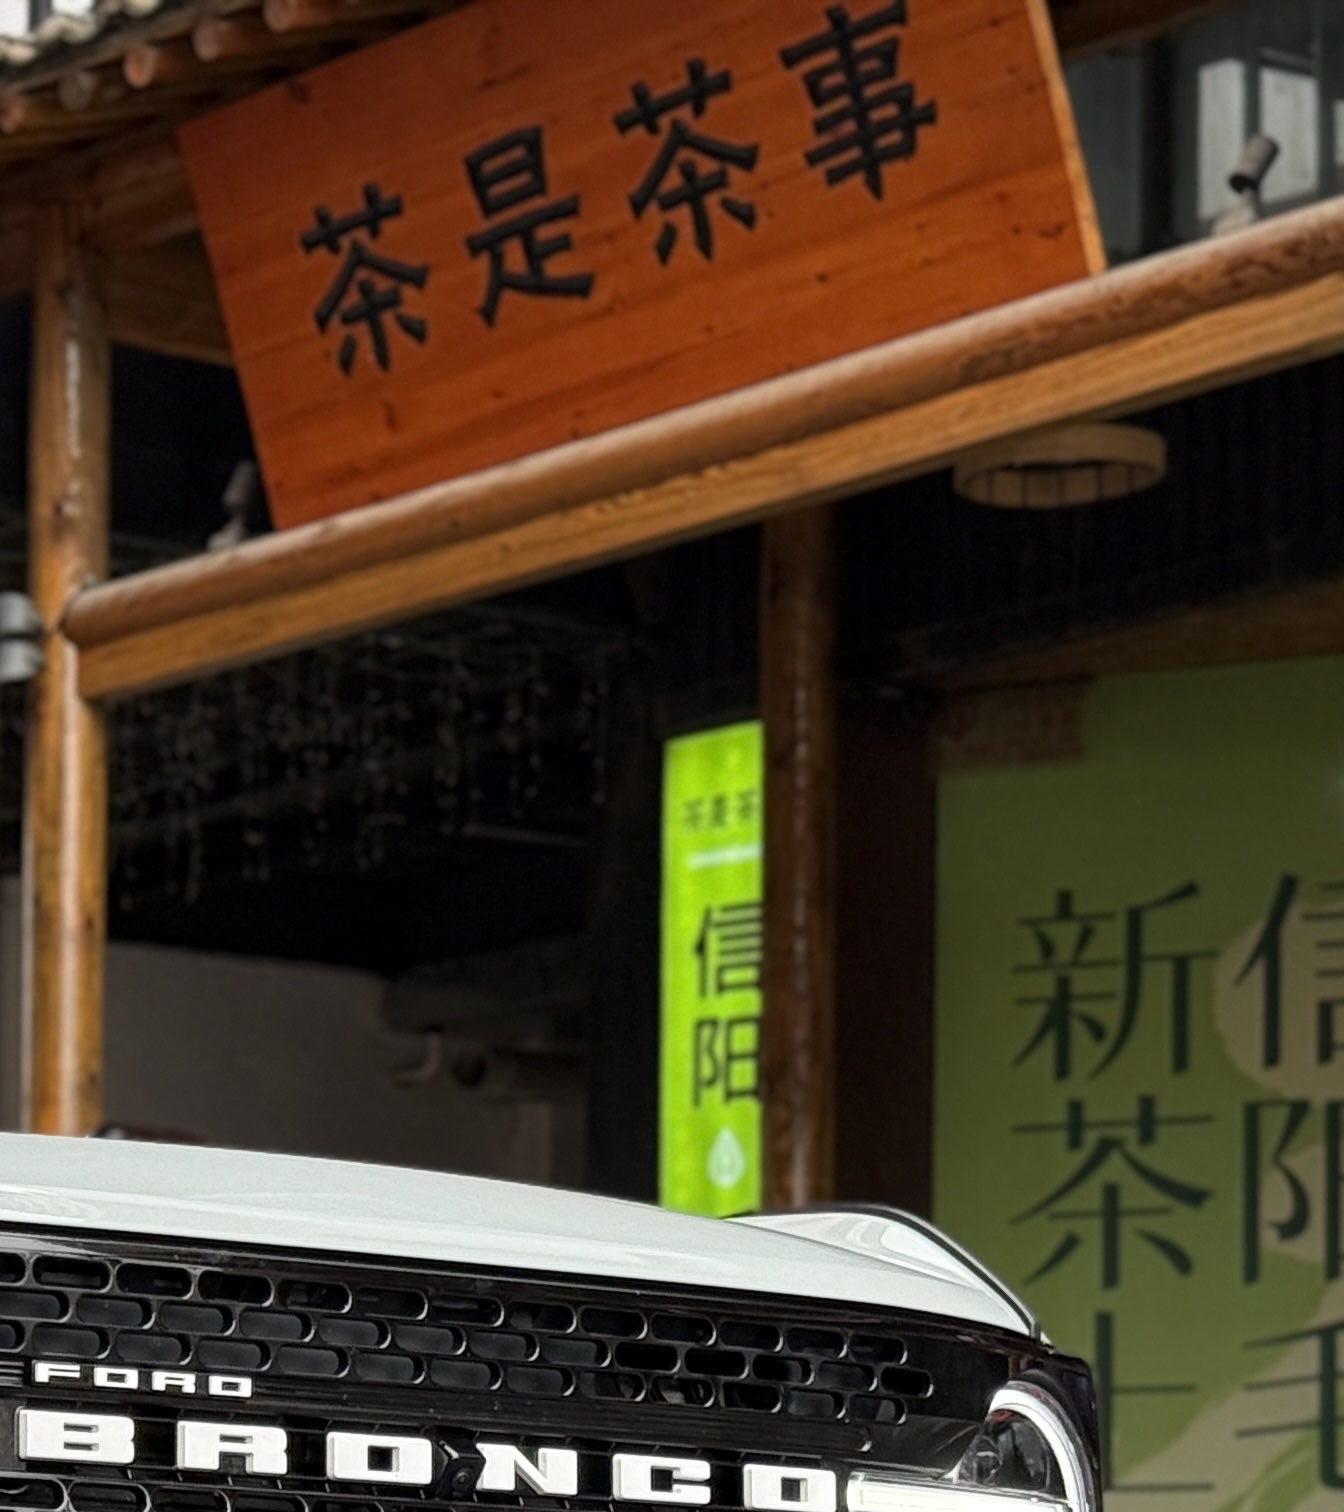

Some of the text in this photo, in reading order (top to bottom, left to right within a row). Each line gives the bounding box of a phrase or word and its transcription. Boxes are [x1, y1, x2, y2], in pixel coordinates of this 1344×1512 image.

[298, 3, 939, 379] 茶是茶事
[692, 902, 762, 1108] 信阳
[33, 1360, 254, 1399] FORD
